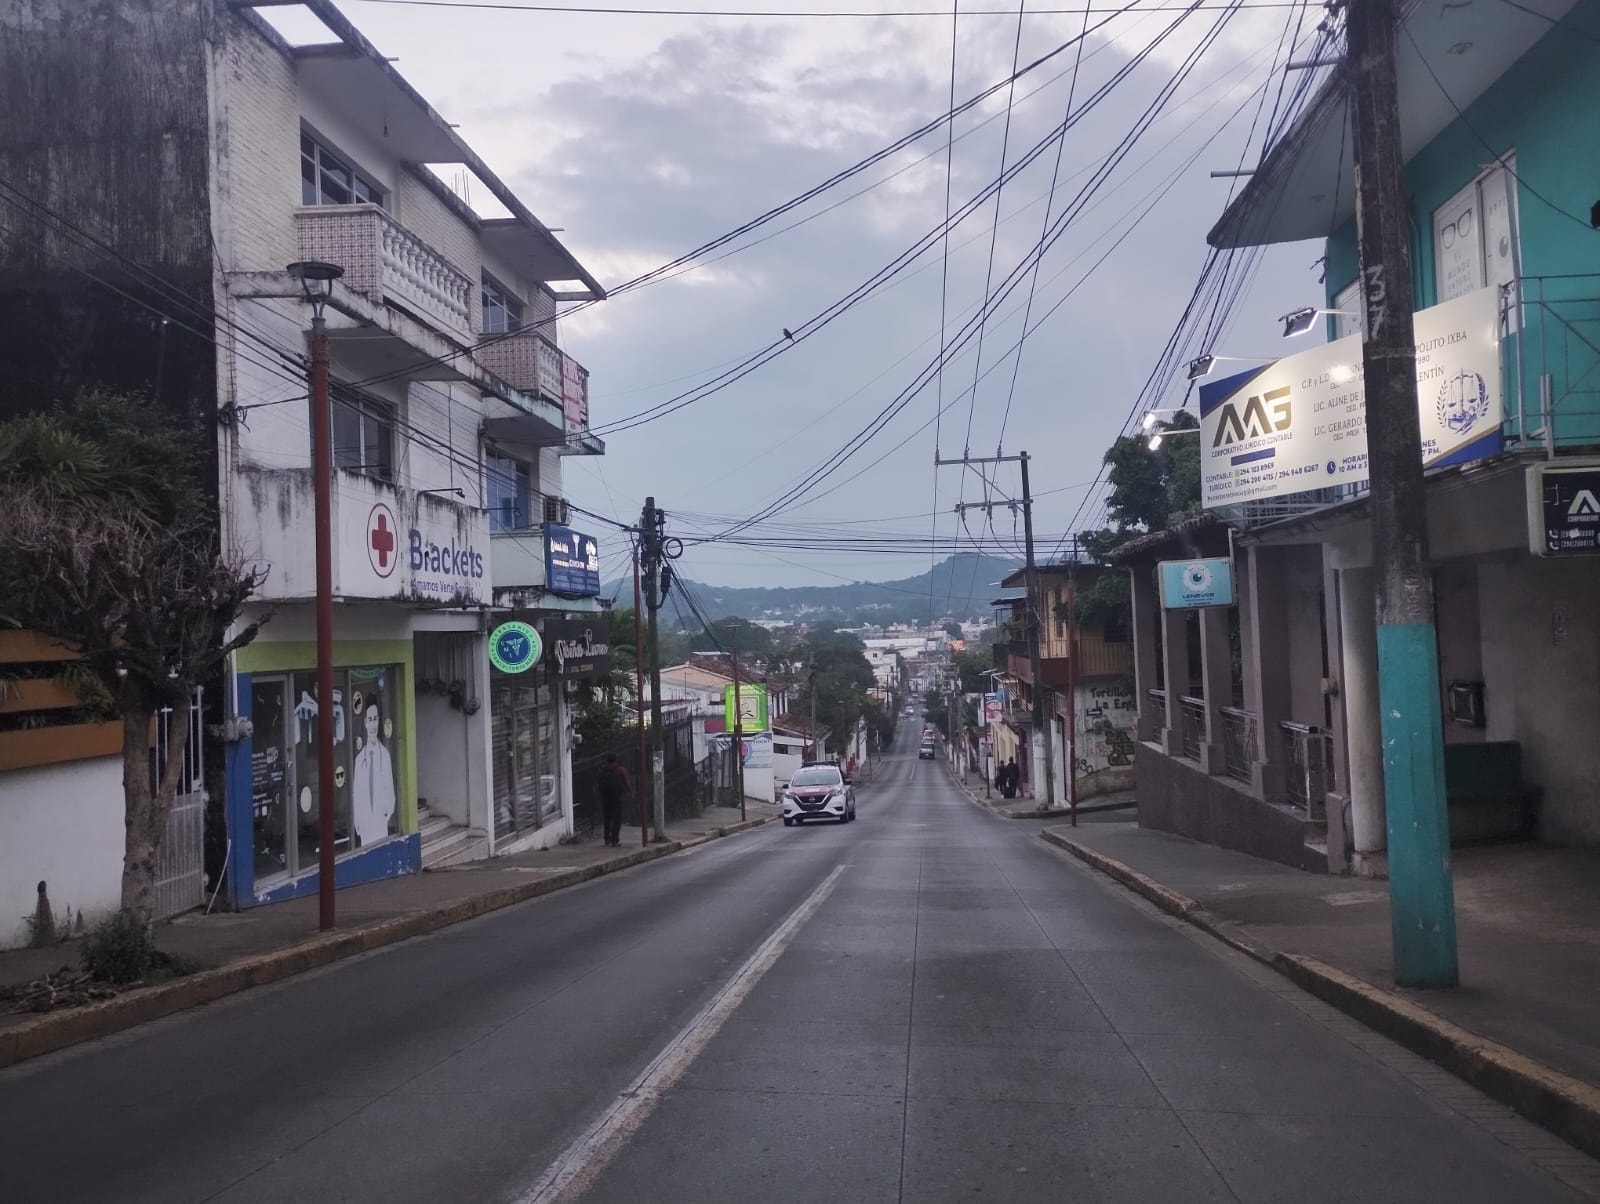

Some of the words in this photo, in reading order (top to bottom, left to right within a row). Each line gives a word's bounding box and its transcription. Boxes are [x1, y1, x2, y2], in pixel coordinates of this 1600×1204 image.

[1447, 331, 1467, 345] IXBA
[1328, 394, 1348, 409] ALINE
[1350, 391, 1359, 403] DE
[1328, 416, 1363, 433] GERARDO
[1211, 444, 1243, 458] CORPORATIVO
[1267, 432, 1293, 444] CONTABLE
[408, 528, 483, 579] Brackets
